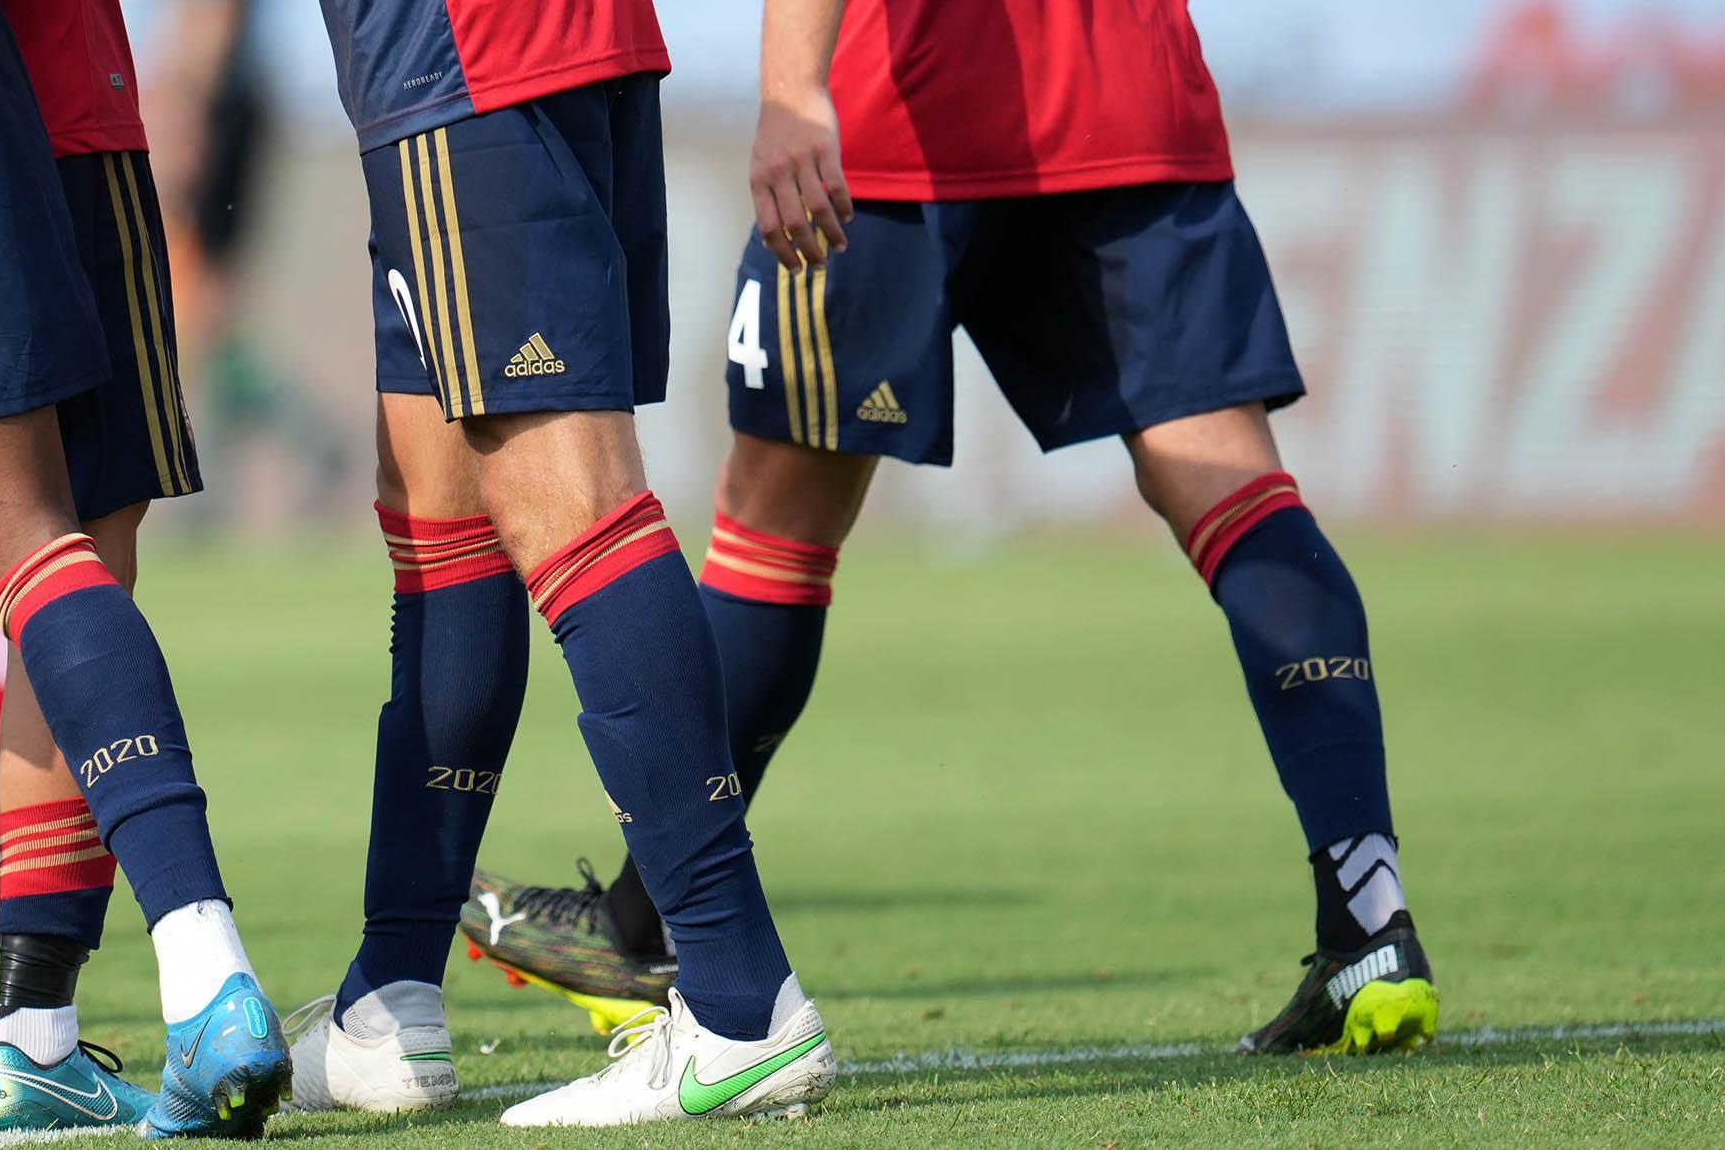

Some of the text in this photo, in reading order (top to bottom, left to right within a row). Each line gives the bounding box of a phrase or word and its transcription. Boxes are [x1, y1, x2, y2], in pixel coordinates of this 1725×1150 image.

[403, 70, 443, 90] AEROREADY
[728, 278, 768, 389] 4
[504, 359, 565, 377] adidas
[857, 407, 907, 423] adidas
[1275, 657, 1368, 690] 2020
[80, 735, 159, 788] 2020
[1326, 944, 1398, 1010] PUMA
